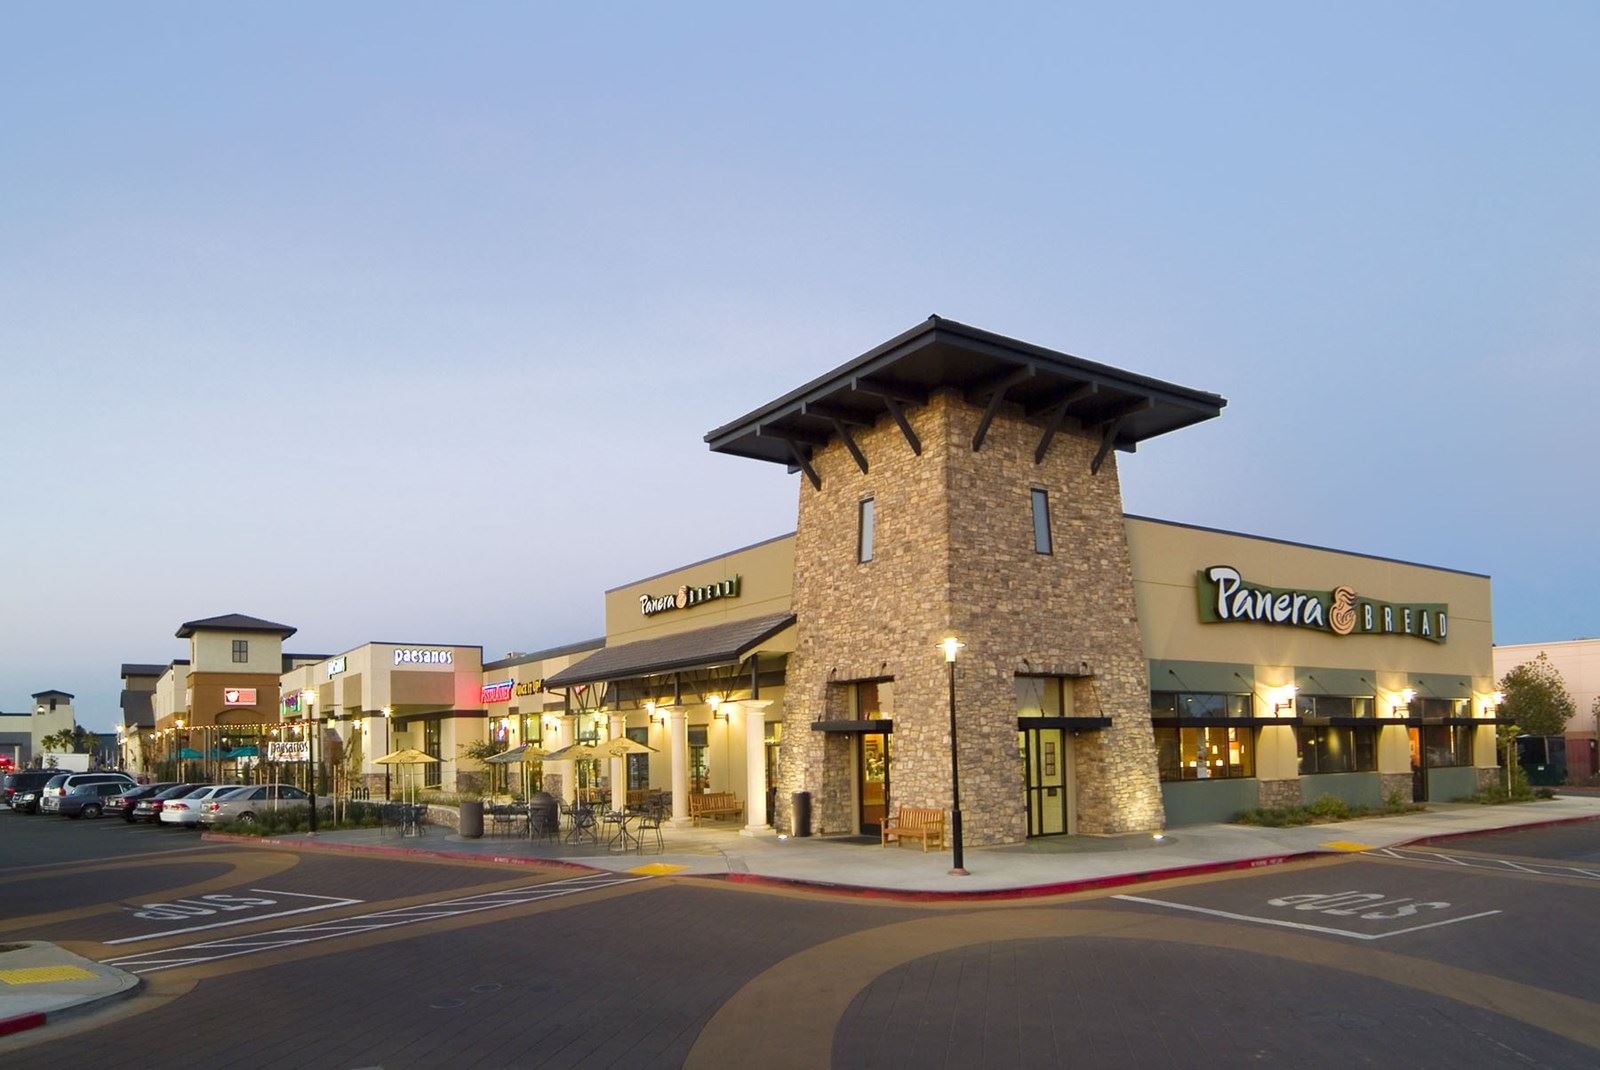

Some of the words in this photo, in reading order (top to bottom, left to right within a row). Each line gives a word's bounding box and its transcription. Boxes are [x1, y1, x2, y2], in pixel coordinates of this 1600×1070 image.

[639, 593, 675, 615] Panera
[689, 581, 730, 604] BREAD
[1209, 566, 1324, 627] Panera
[1364, 603, 1447, 637] BREAD
[393, 648, 453, 667] paesanos
[133, 894, 278, 920] STOP
[1267, 890, 1451, 920] STOP
